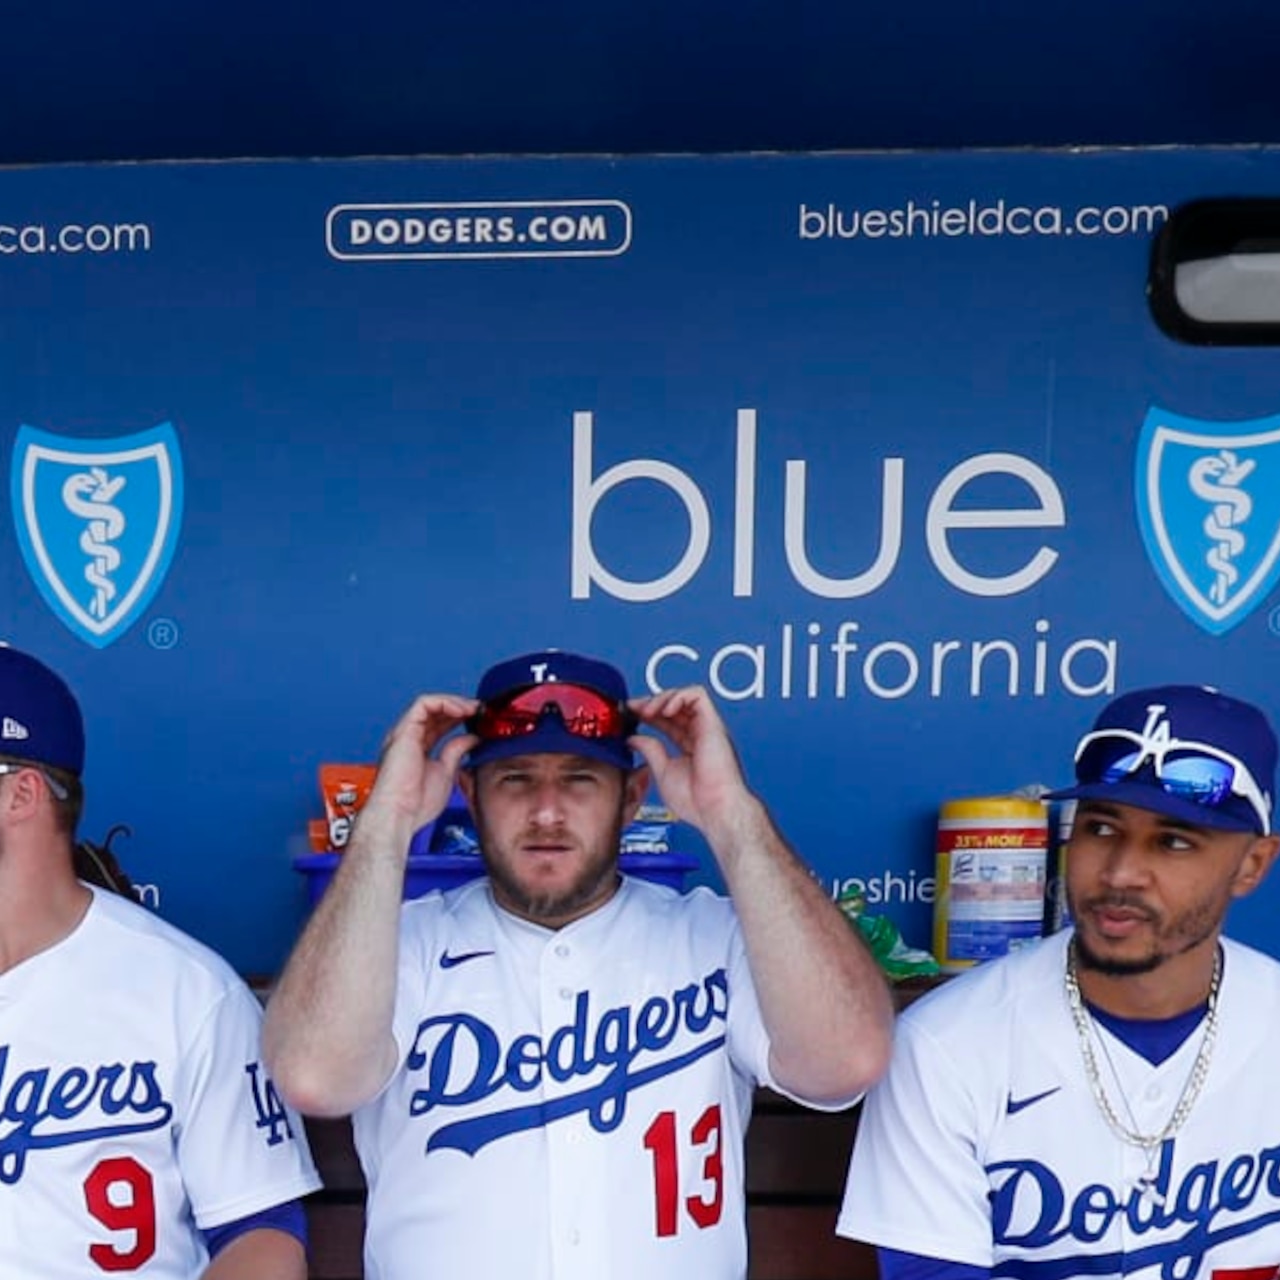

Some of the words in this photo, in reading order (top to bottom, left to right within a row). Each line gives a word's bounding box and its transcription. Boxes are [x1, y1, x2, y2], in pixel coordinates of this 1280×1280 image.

[349, 214, 607, 246] DODGERS.COM
[798, 199, 1168, 239] blueshieldca.com
[570, 408, 1066, 603] blue
[645, 620, 1118, 700] california
[406, 968, 728, 1134] Dodgers
[82, 1155, 157, 1274] 9
[643, 1103, 725, 1238] 13
